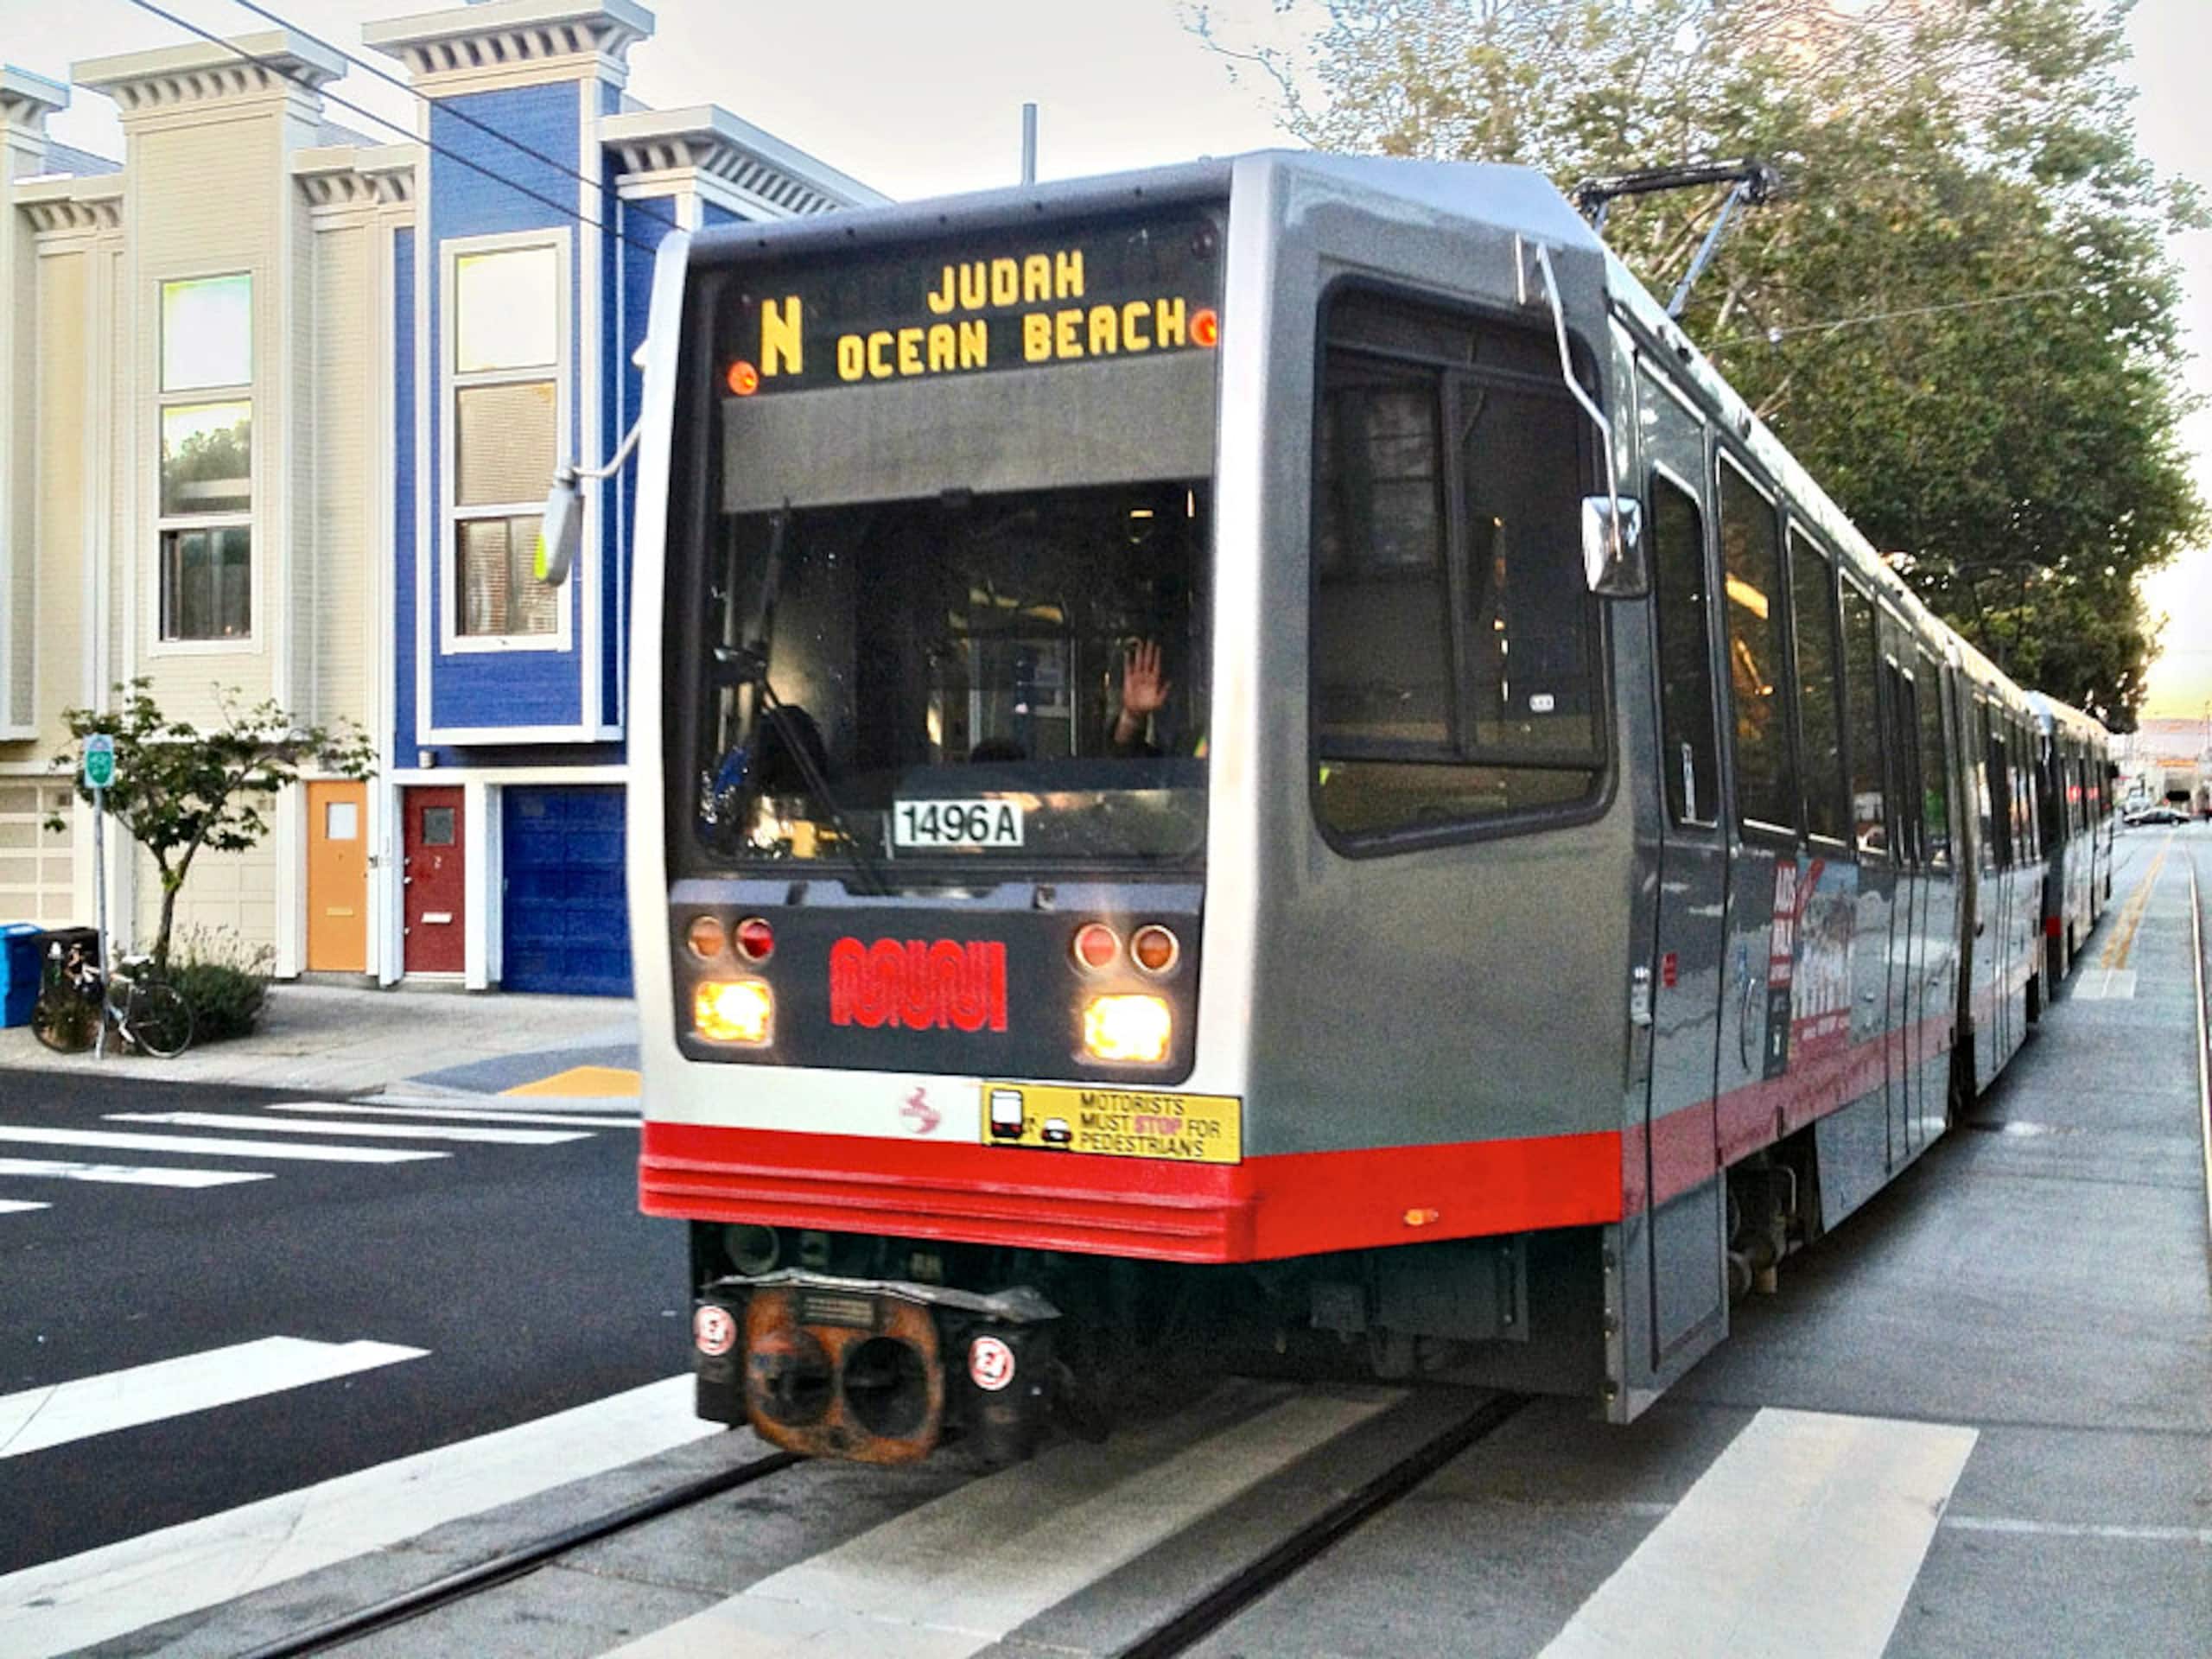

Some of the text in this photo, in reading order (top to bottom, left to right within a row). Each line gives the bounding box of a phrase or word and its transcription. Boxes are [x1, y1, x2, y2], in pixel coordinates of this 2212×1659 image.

[927, 249, 1085, 314] JUDAH
[760, 295, 803, 377] N
[836, 297, 1186, 381] OCEAN BEACH
[901, 804, 1018, 842] 1496A
[1081, 1092, 1185, 1116] MOTORISTS
[1080, 1131, 1204, 1157] PEDESTRIANS
[1081, 1112, 1221, 1139] MUST STOP FOR
